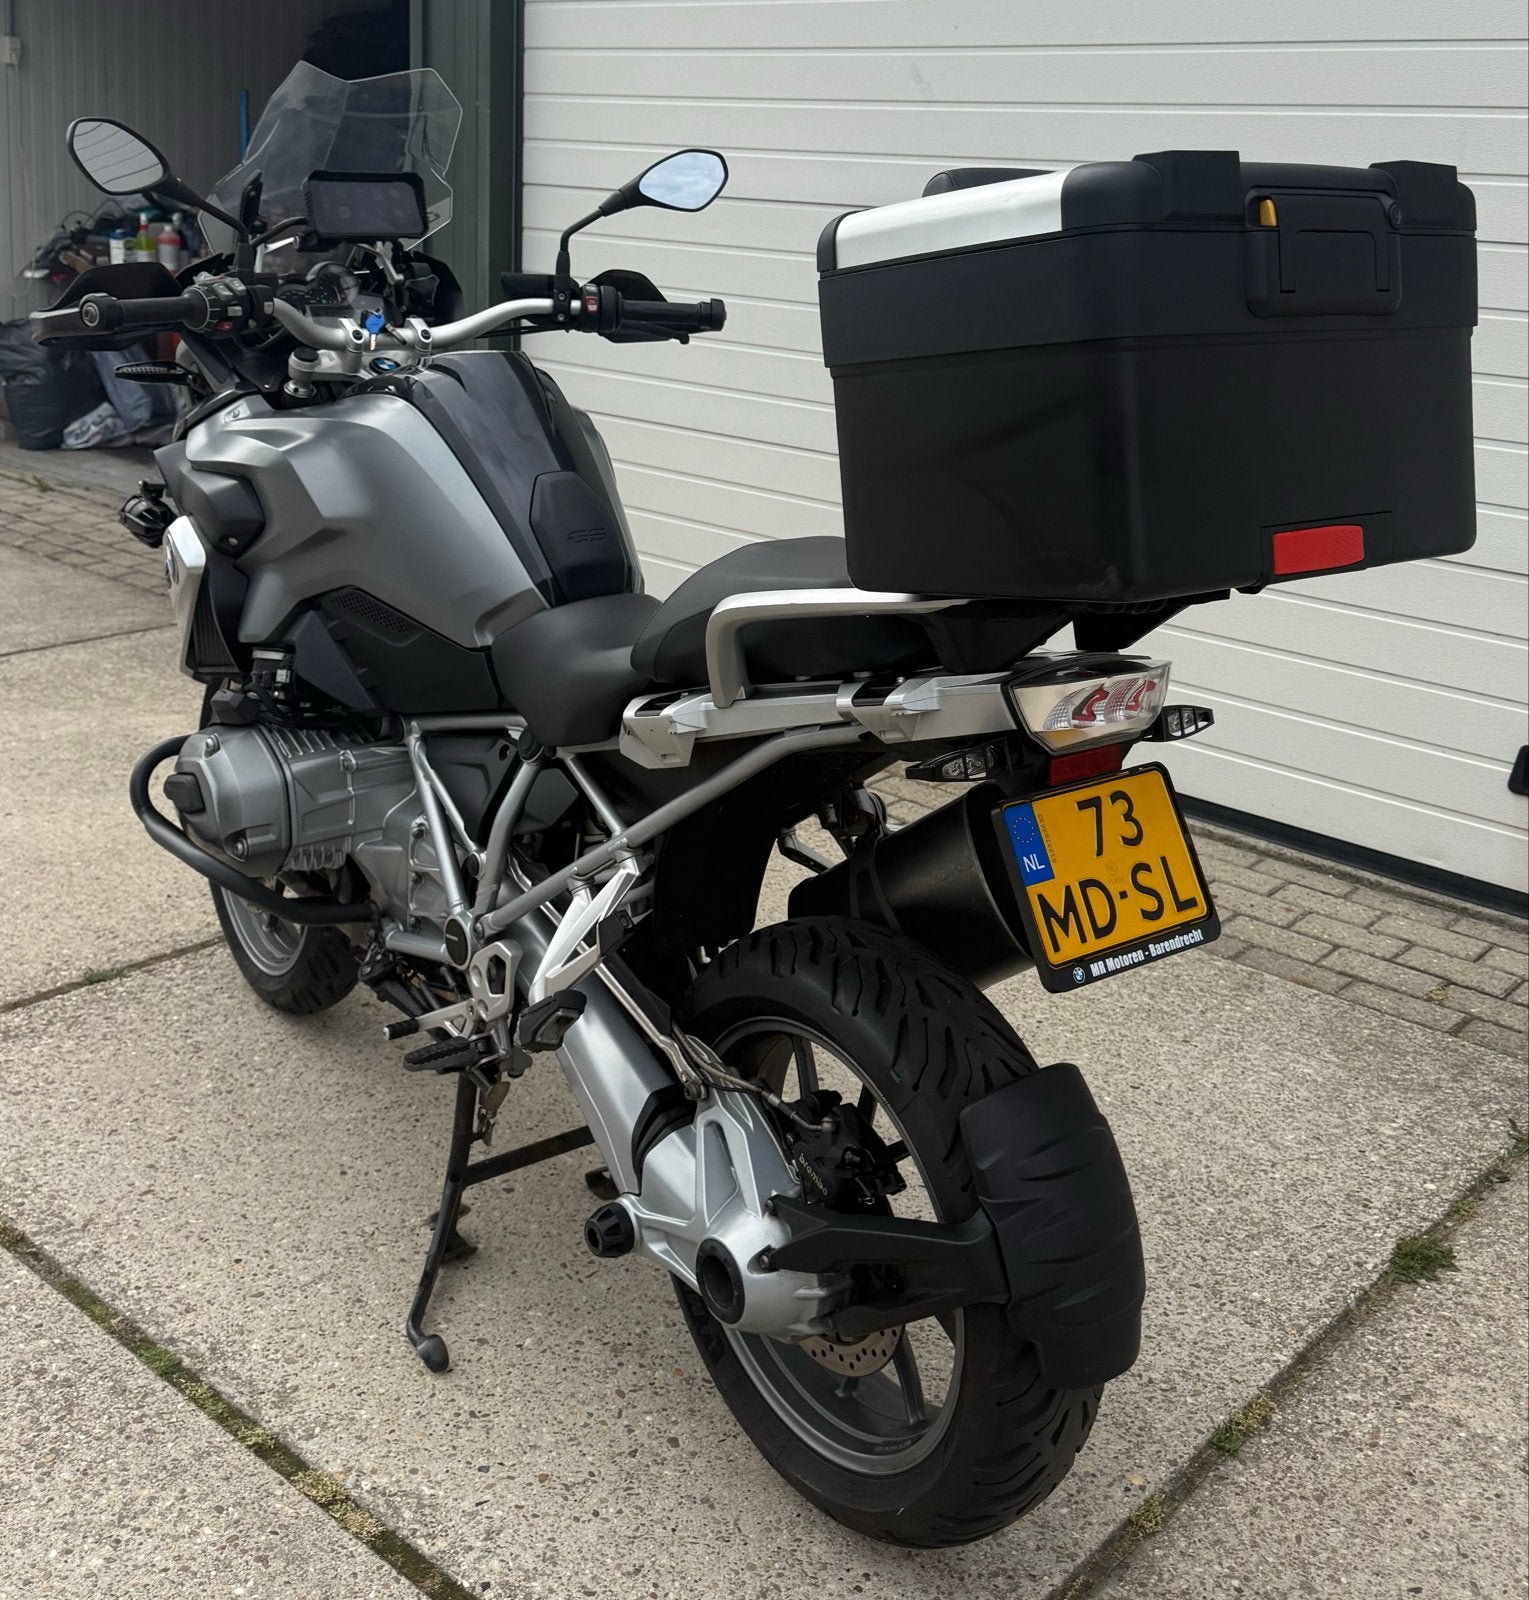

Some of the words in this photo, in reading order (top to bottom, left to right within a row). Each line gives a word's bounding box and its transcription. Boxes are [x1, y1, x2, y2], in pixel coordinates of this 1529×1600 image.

[1076, 790, 1144, 857] 73
[1022, 853, 1046, 873] NL
[1090, 960, 1107, 977] MR
[1105, 949, 1145, 972] Motoren
[1148, 928, 1204, 957] Barendrecht
[800, 1153, 828, 1196] brembo
